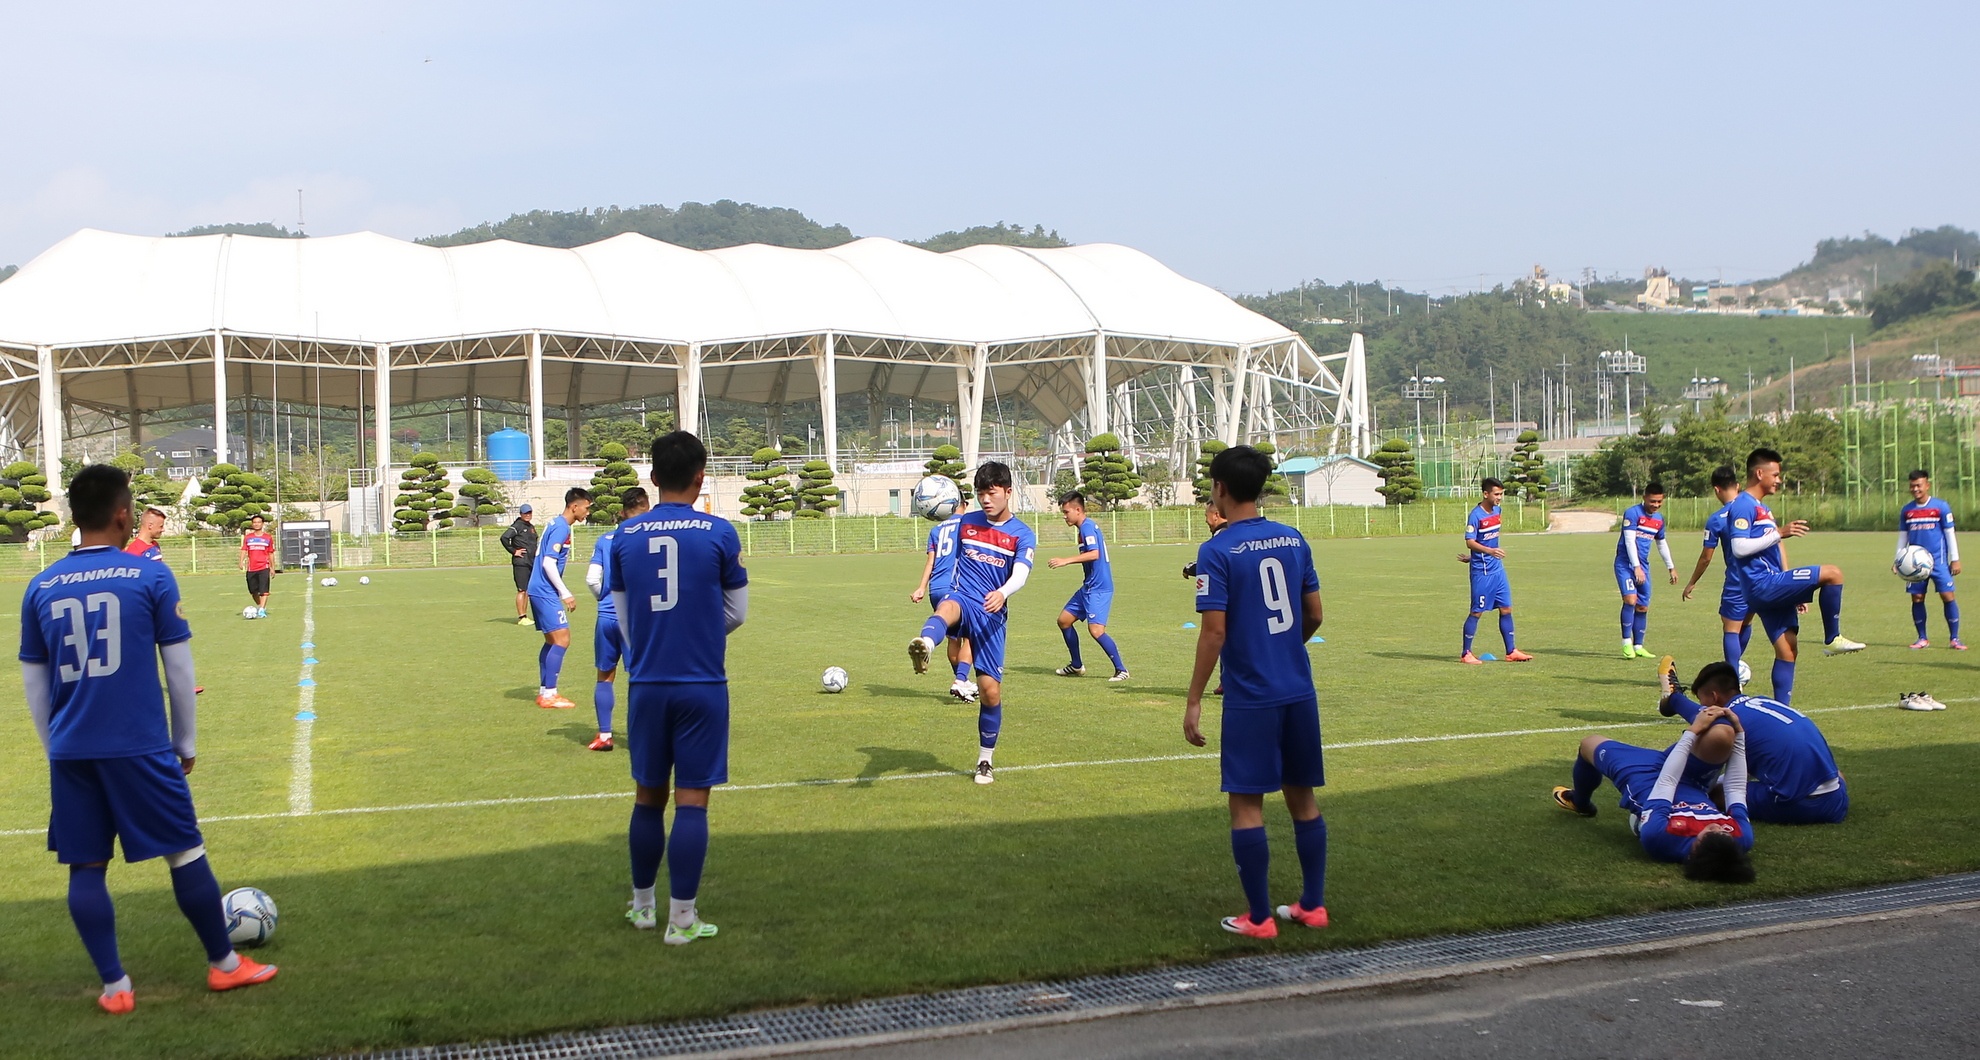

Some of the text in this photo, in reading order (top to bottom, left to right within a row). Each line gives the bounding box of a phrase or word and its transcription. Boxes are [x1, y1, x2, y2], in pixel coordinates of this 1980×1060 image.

[642, 519, 712, 532] YANMAR
[936, 525, 956, 558] 15
[1247, 536, 1300, 551] YANMAR
[58, 567, 141, 585] YANMAR
[648, 536, 678, 611] 3
[1792, 569, 1812, 580] 16
[1625, 579, 1635, 591] 13
[1259, 557, 1294, 635] 9
[1479, 596, 1485, 608] 5
[51, 592, 121, 683] 33
